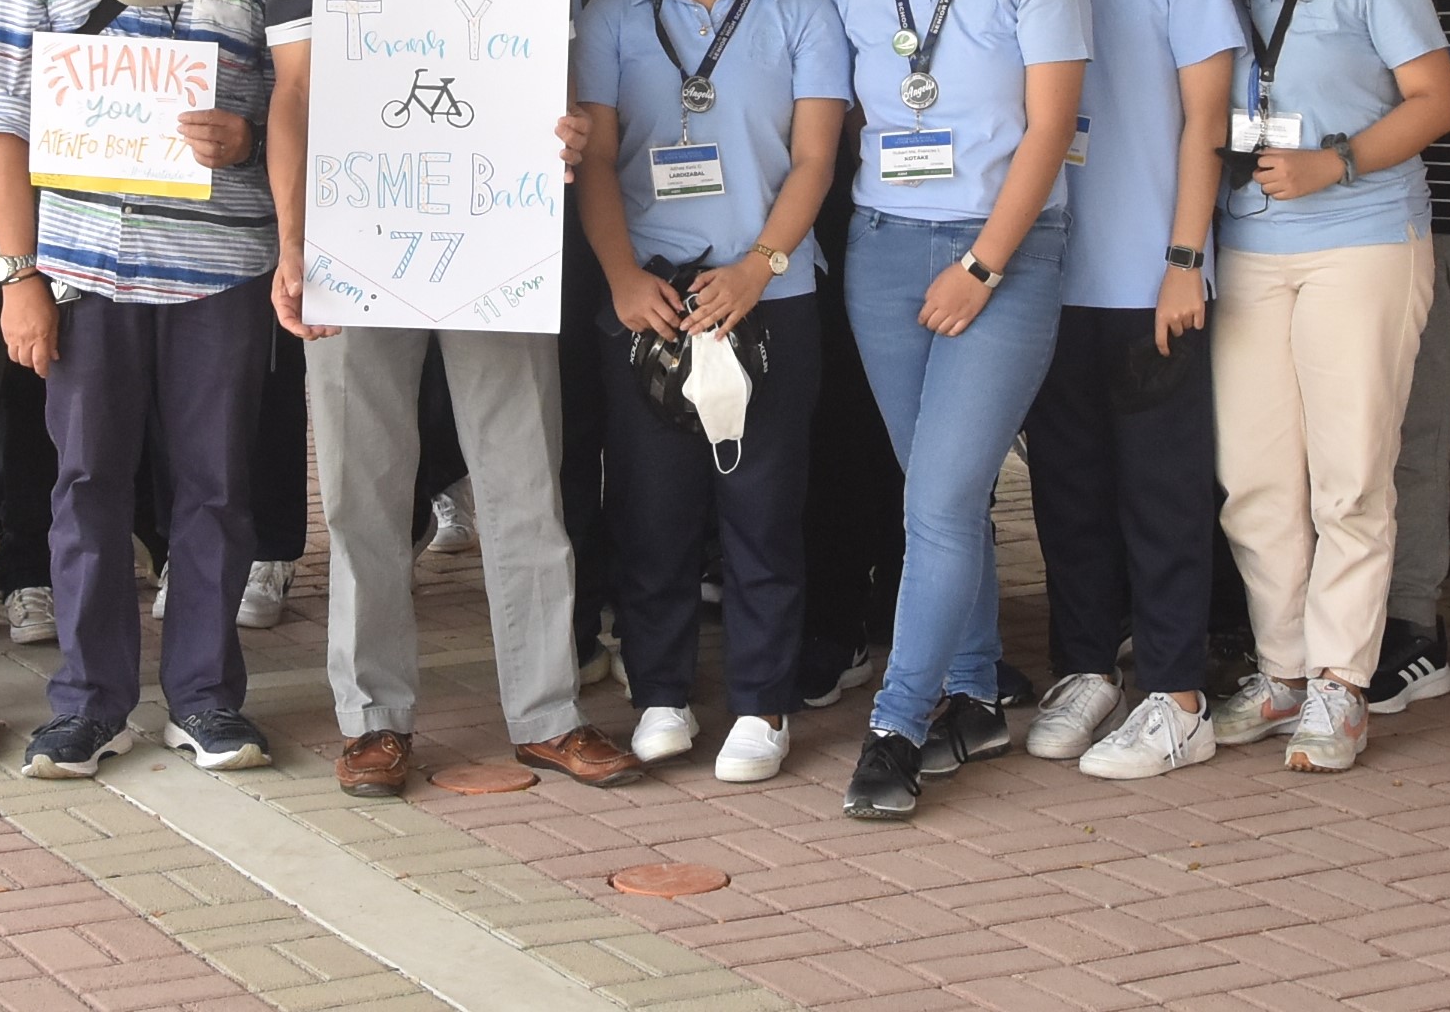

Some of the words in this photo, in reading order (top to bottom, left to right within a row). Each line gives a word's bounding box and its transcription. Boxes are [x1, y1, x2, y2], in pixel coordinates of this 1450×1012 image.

[898, 1, 908, 28] SCHOO
[933, 4, 947, 34] SENIOR
[712, 37, 728, 61] SENIOR
[726, 20, 737, 36] HIGH
[51, 44, 189, 95] THANK
[85, 95, 152, 128] you
[37, 129, 99, 160] ATENEO
[105, 135, 149, 163] BSME
[315, 151, 452, 215] BSME
[470, 153, 556, 217] Batch
[376, 224, 465, 283] '77
[474, 295, 501, 324] 11
